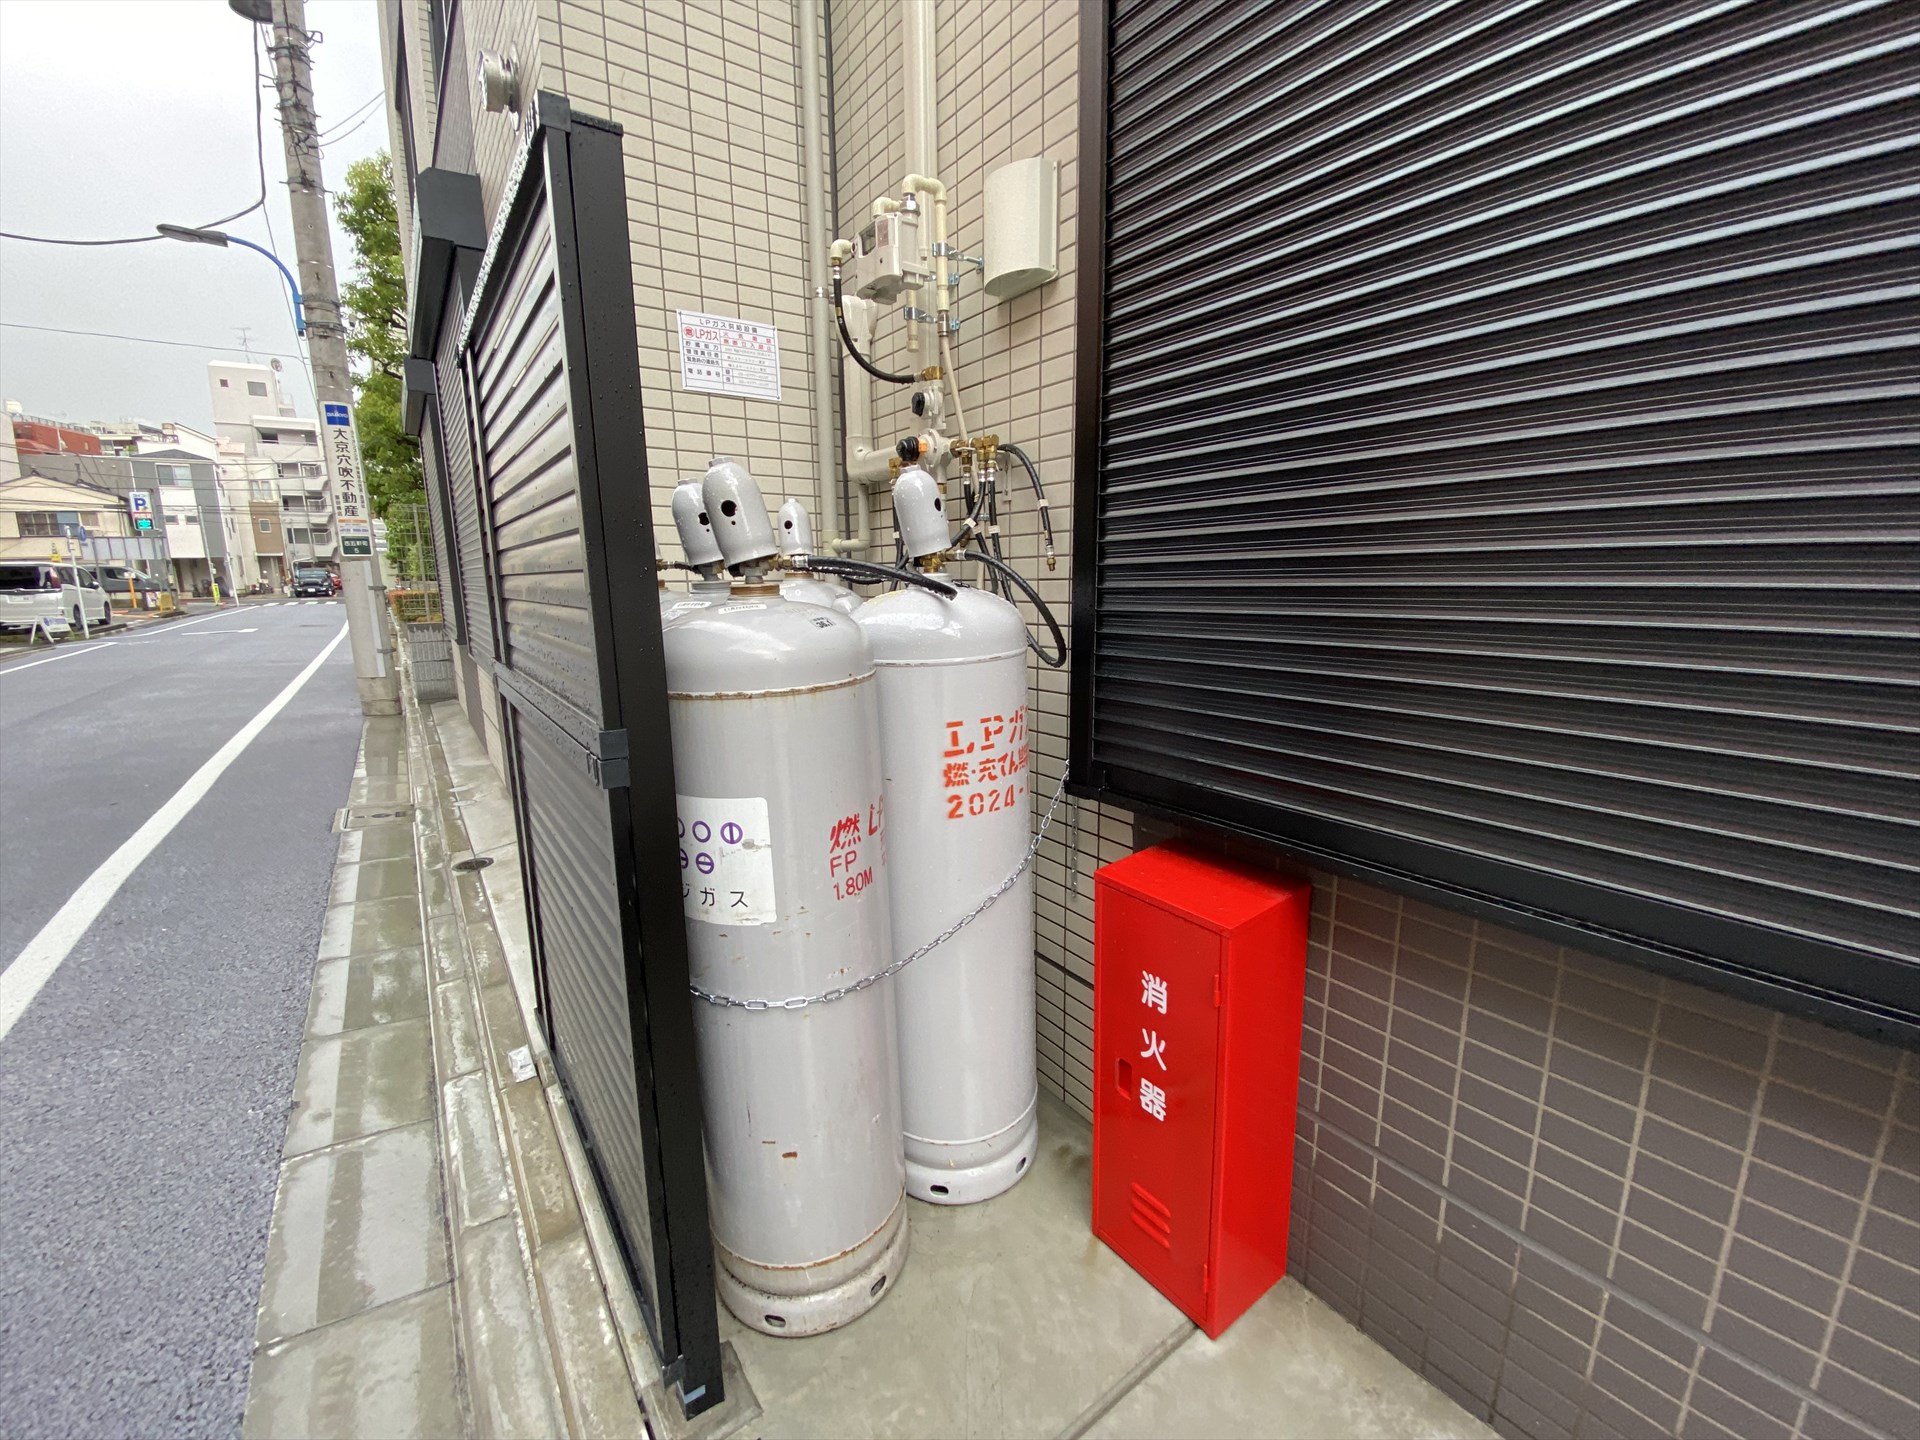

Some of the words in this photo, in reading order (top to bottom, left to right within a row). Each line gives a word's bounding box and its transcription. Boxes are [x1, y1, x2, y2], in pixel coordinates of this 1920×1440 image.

[699, 318, 758, 334] LPガス供給設備
[333, 428, 359, 517] 大京穴吹不動産
[134, 498, 146, 511] P
[943, 705, 1029, 758] LPガ
[830, 812, 861, 854] 燃
[829, 850, 857, 878] FP
[833, 866, 873, 900] 1.80M
[1139, 970, 1168, 1122] 消火器
